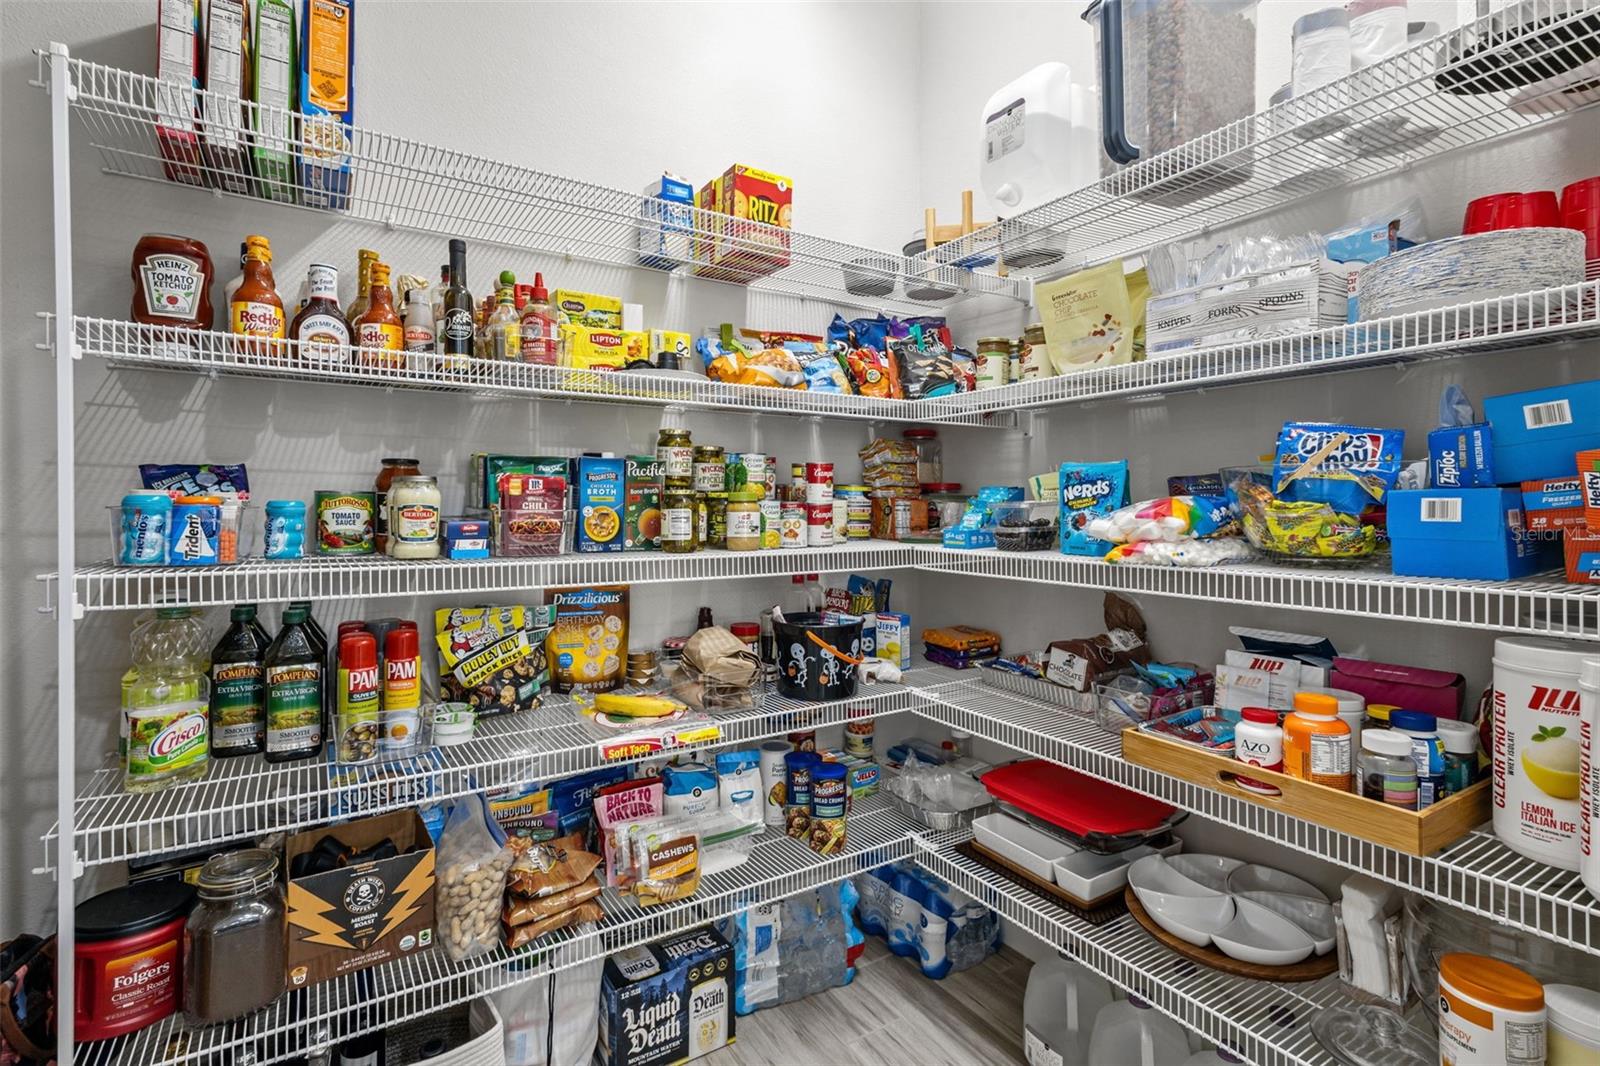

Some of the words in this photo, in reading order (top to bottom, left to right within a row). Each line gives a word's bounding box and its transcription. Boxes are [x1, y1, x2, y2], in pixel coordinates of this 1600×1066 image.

[749, 196, 779, 225] RITZ
[156, 260, 189, 272] HEINZ
[152, 272, 194, 286] TOMATO
[153, 281, 193, 291] KETCHUP
[1053, 290, 1098, 308] CHOCOLATE
[1258, 290, 1304, 308] SPOONS
[240, 310, 281, 328] RedHot
[1208, 304, 1242, 319] FORKS
[1157, 314, 1192, 330] KNIVES
[360, 331, 391, 342] edHot
[591, 334, 622, 344] LIPTON
[626, 460, 666, 478] Pacific
[1440, 450, 1460, 484] Ziploc
[1544, 482, 1581, 492] Hefty
[522, 502, 548, 510] CHILI
[1542, 494, 1582, 503] FREEZER
[331, 512, 361, 520] TOMATO
[136, 514, 150, 558] mentos
[184, 515, 200, 560] Trident
[554, 592, 621, 606] Drizzilicious
[557, 616, 606, 625] BIRTHDAY
[876, 622, 900, 632] JIFFY
[462, 647, 500, 677] HONEY
[499, 635, 520, 655] NUT
[220, 668, 262, 680] POMPEIAN
[273, 670, 316, 684] POMPEIAN
[388, 660, 416, 680] PAM
[467, 662, 499, 686] SNACK
[1048, 663, 1083, 681] CHOCOLATE
[218, 686, 240, 694] EXTRA
[240, 684, 262, 692] VIRGIN
[350, 669, 378, 691] PAM
[272, 690, 294, 698] EXTRA
[294, 686, 318, 696] VIRGIN
[1540, 706, 1581, 717] NUTRITI
[224, 726, 257, 735] SMOOTH
[1494, 690, 1506, 757] PROTEIN
[158, 723, 201, 756] Crisco
[280, 729, 310, 738] SMOOTH
[608, 746, 629, 759] Soft
[630, 744, 650, 755] Taco
[1240, 739, 1271, 754] AZO
[1507, 730, 1515, 757] ISOLATE
[1507, 758, 1515, 776] WHEY
[1580, 720, 1592, 796] PROTEIN
[1494, 758, 1506, 809] CLEAR
[606, 790, 636, 812] BACK
[637, 788, 652, 802] TO
[1520, 800, 1554, 818] LEMON
[607, 802, 656, 824] NATURE
[1520, 811, 1558, 830] ITALIAN
[1559, 820, 1577, 834] ICE
[1580, 797, 1592, 856] CLEAR
[652, 843, 694, 862] CASHEWS
[350, 912, 378, 924] MEDIUM
[353, 918, 375, 929] ROAST
[113, 961, 170, 990] Folgers
[112, 986, 145, 1002] Classic
[146, 976, 172, 991] Roast
[694, 988, 724, 1014] Death
[622, 992, 680, 1034] Liquid
[627, 1015, 680, 1056] Death
[628, 1048, 660, 1065] MOUNTAIN
